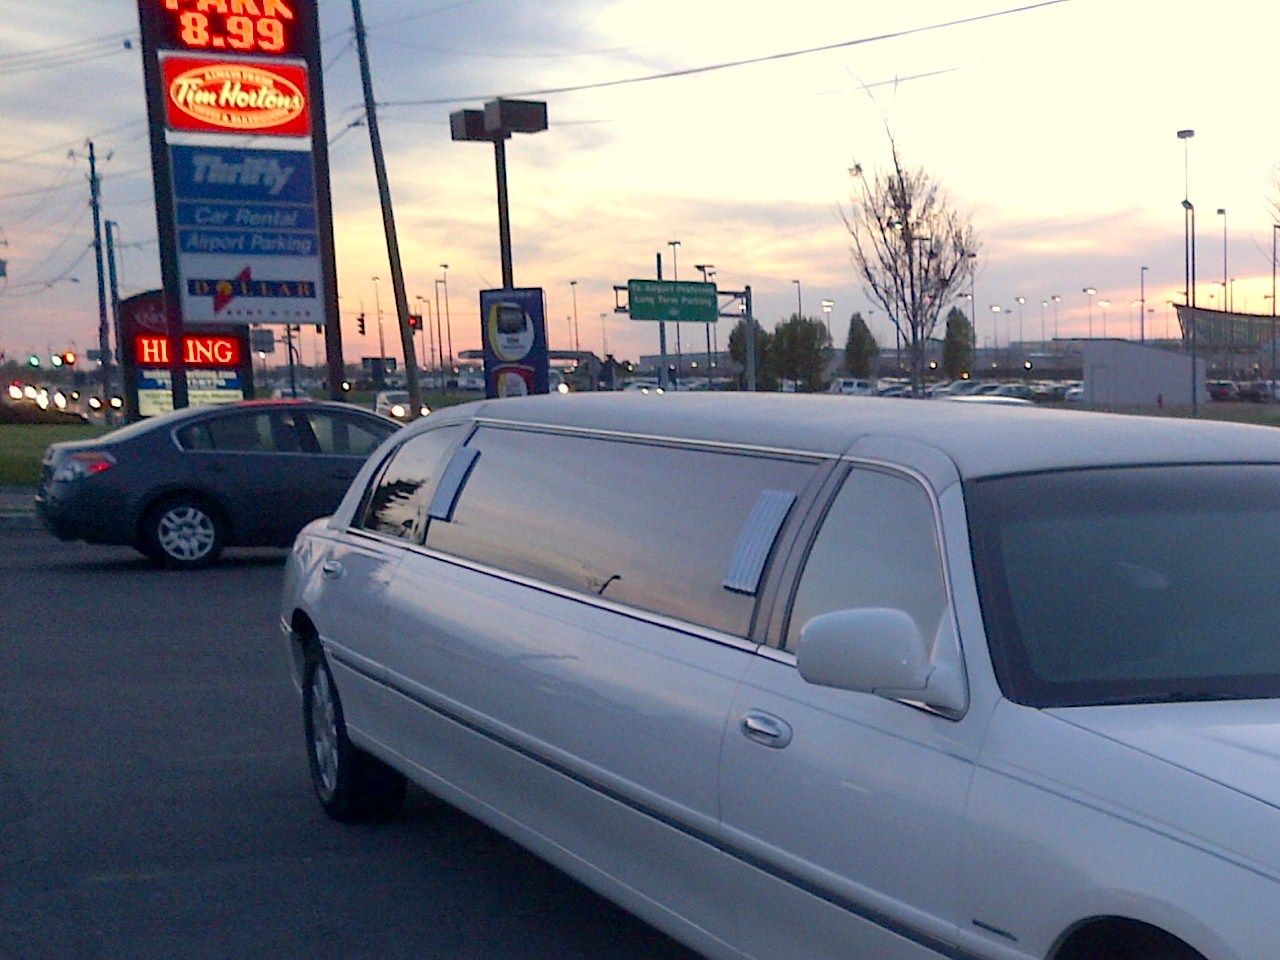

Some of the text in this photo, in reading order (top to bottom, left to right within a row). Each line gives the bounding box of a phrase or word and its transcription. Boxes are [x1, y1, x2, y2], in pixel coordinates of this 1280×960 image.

[180, 11, 285, 51] 8.99
[174, 78, 217, 107] Tim
[219, 80, 300, 110] Hortons
[192, 154, 294, 196] Thrifty
[141, 339, 233, 363] HIING
